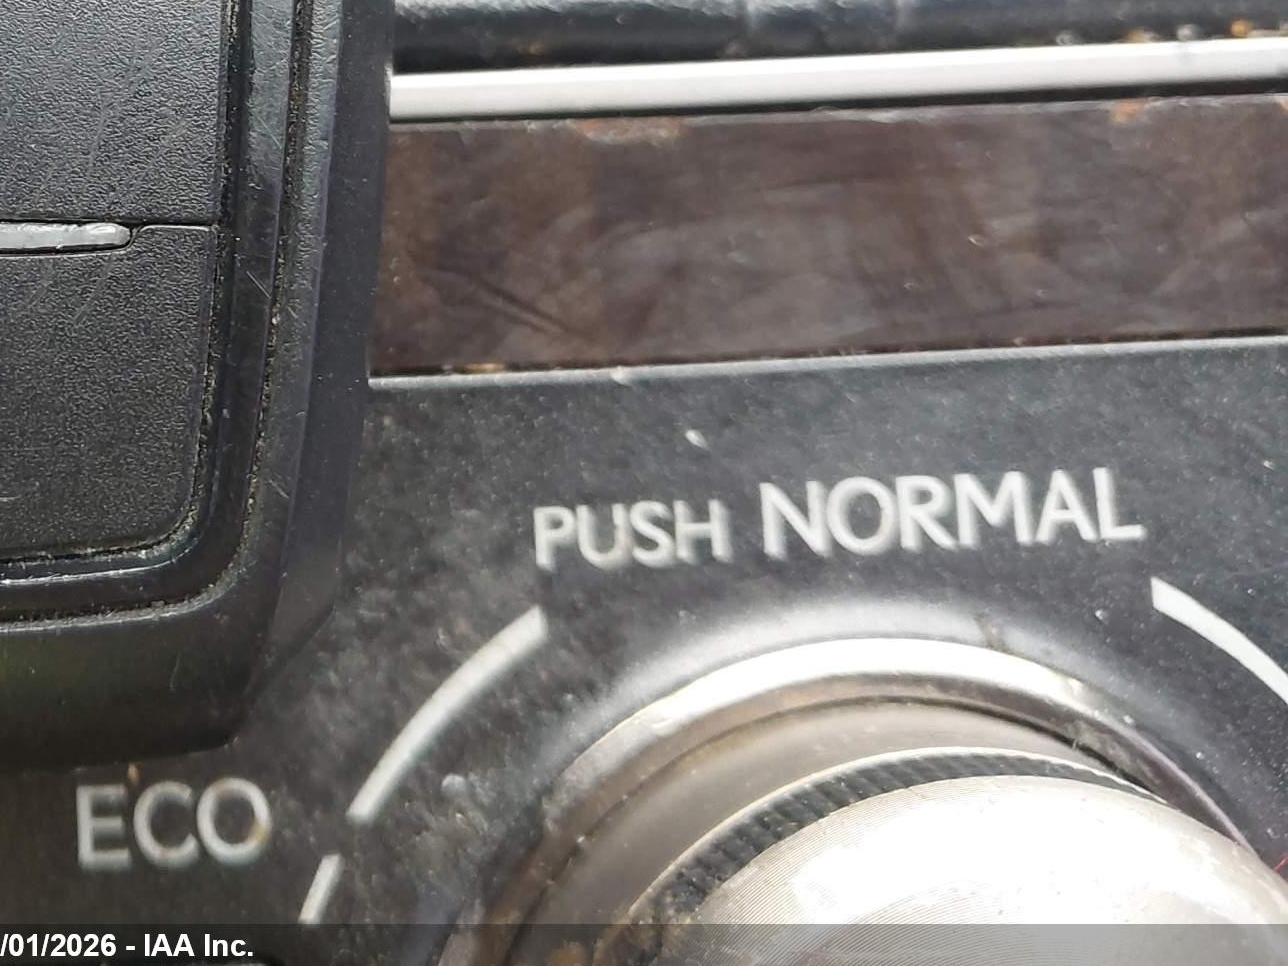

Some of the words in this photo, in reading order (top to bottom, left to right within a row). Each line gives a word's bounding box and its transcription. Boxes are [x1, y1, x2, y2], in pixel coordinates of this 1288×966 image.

[533, 500, 732, 570] PUSH
[759, 467, 1145, 559] NORMAL
[76, 777, 273, 872] ECO
